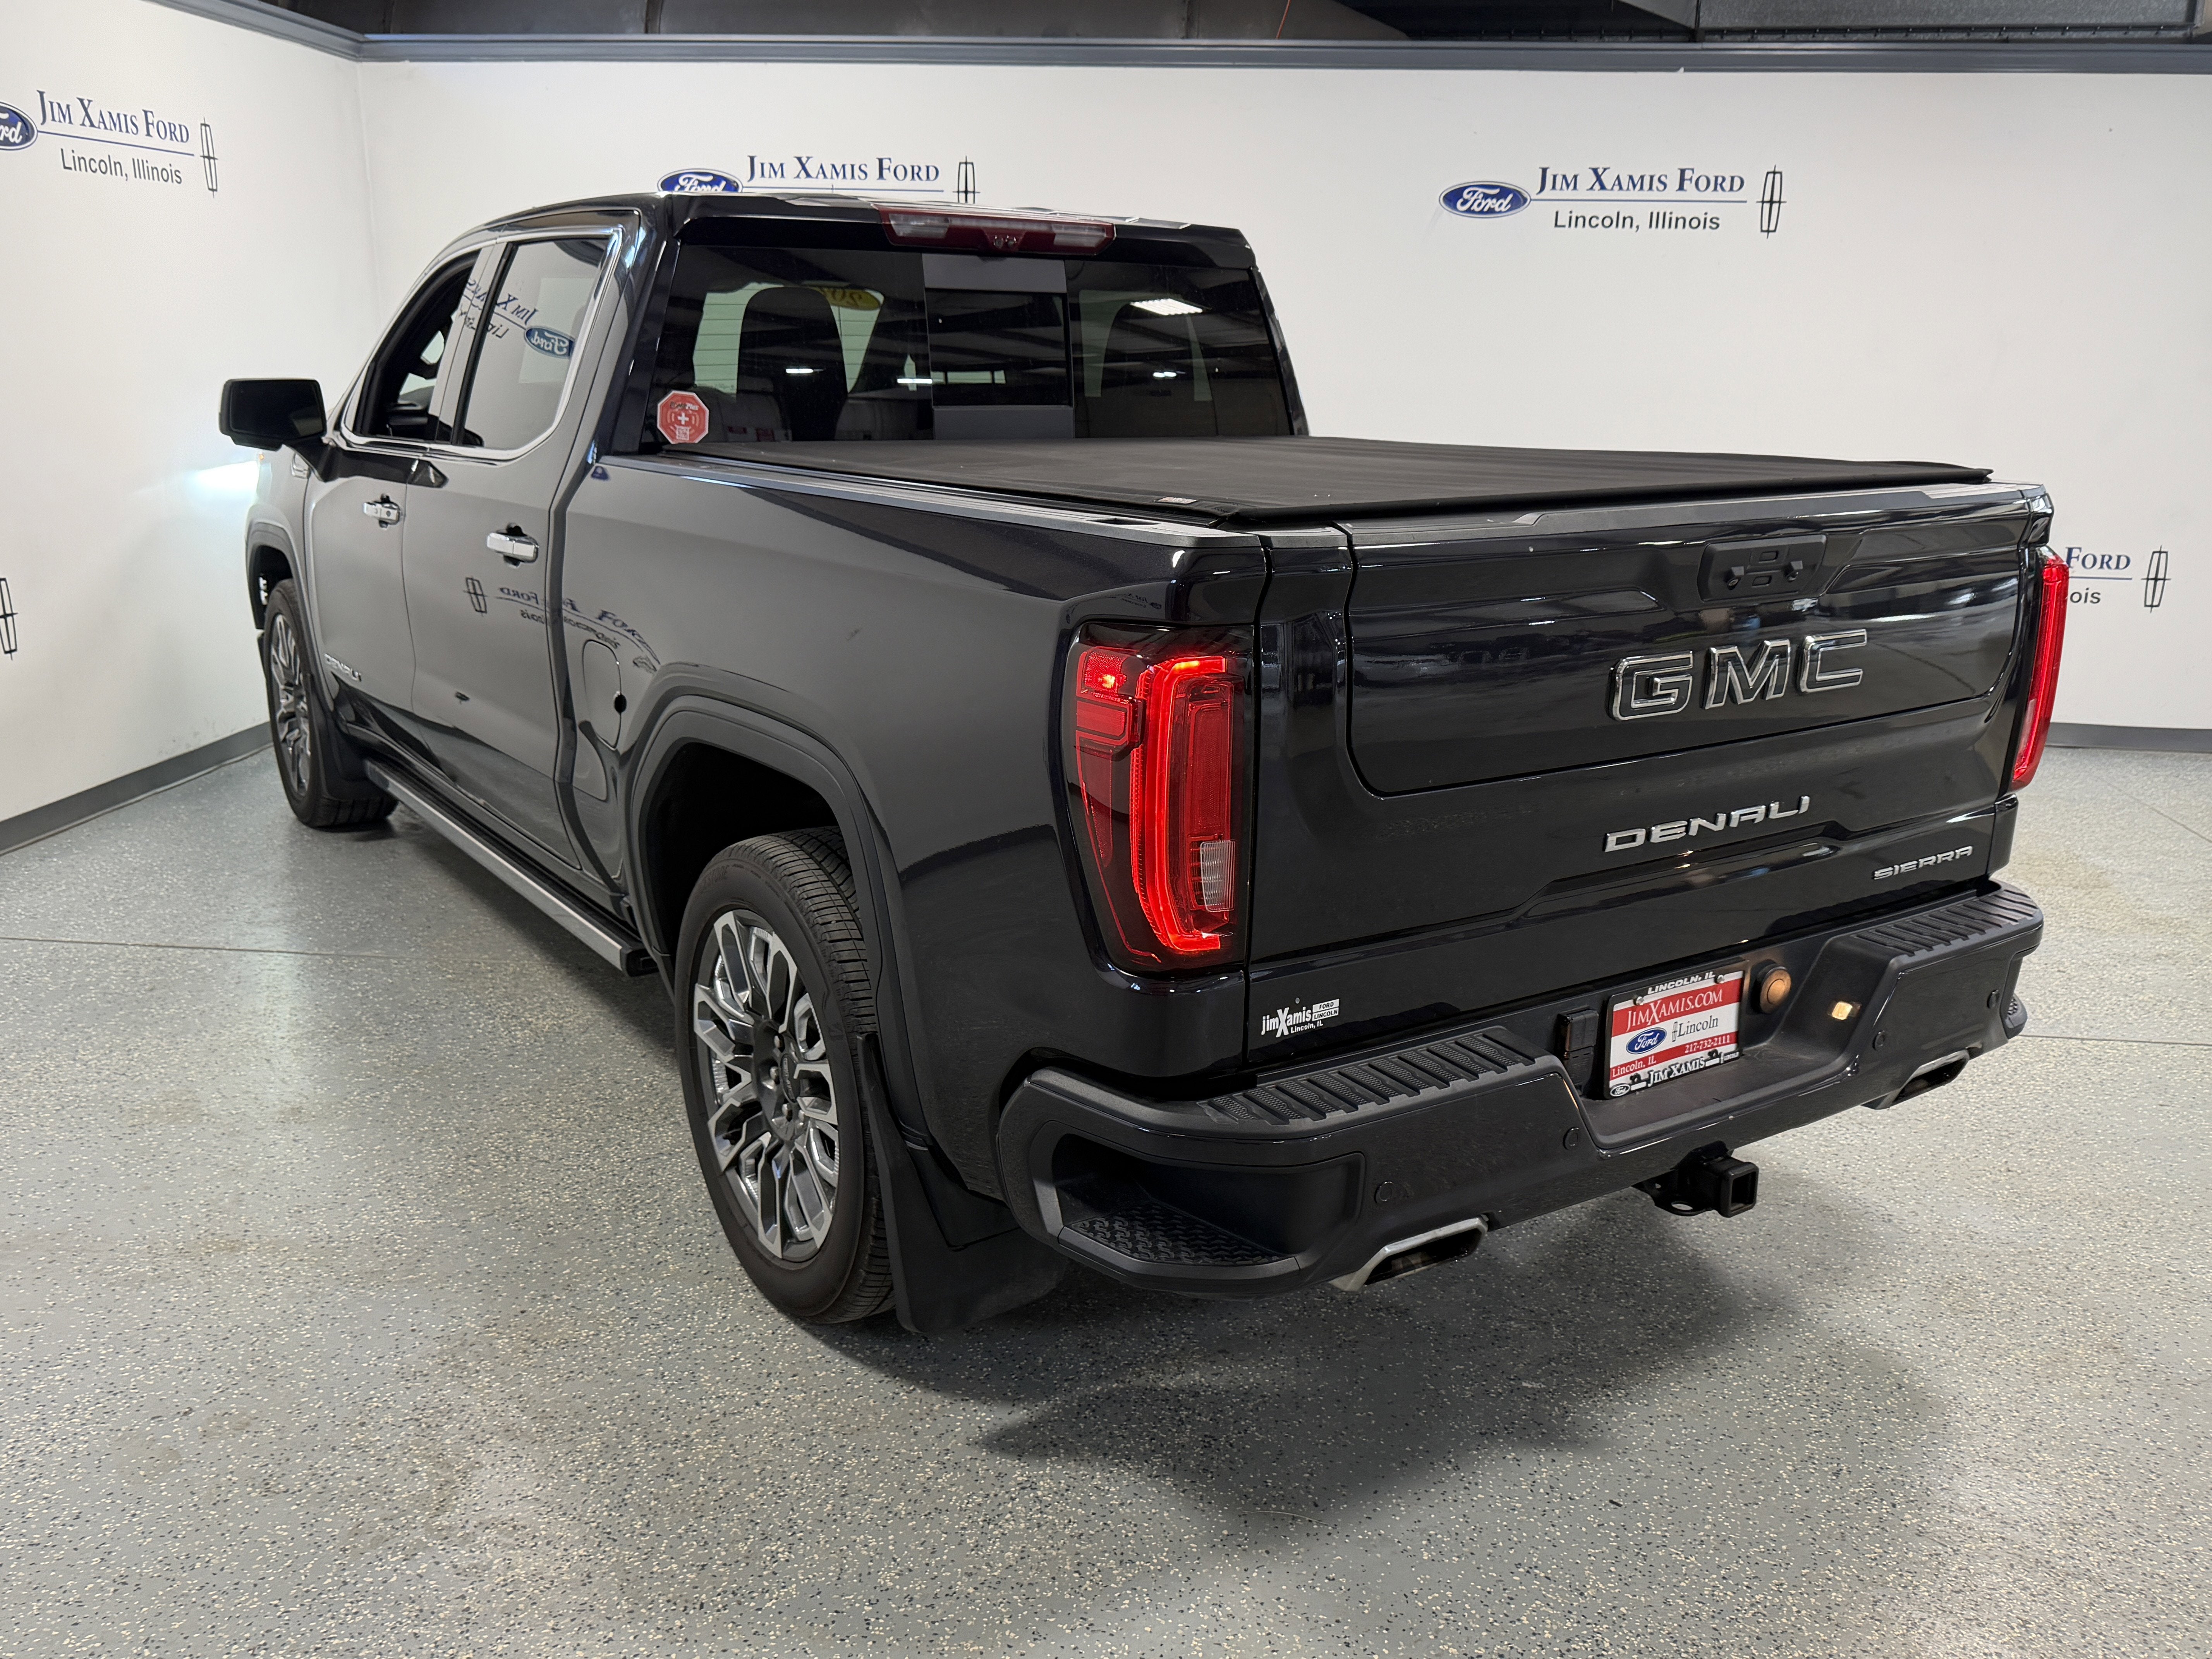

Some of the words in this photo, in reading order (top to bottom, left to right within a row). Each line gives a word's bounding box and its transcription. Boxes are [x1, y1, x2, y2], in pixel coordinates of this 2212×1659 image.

[36, 89, 74, 125] JIM
[76, 97, 139, 136] XAMIS
[141, 108, 189, 143] FORD
[60, 148, 128, 181] Lincoln,
[132, 158, 182, 184] Illinois
[747, 156, 785, 183] JIM
[793, 156, 868, 180] XAMIS
[876, 157, 939, 182] FORD
[1536, 167, 1579, 194] JIM
[1586, 167, 1668, 192] XAMIS
[1676, 167, 1745, 192] FORD
[1456, 187, 1511, 214] Ford
[1554, 210, 1640, 232] Lincoln,
[1648, 211, 1721, 230] Illinois
[2064, 546, 2131, 570] FORD
[1605, 629, 1868, 721] GMC
[1604, 795, 1810, 852] DENALI
[1873, 845, 1973, 880] SIERRA
[1647, 975, 1702, 994] LINCOLN,
[1704, 971, 1716, 980] IL
[1314, 1009, 1338, 1020] LINCOLN
[1319, 1001, 1334, 1010] FORD
[1290, 1022, 1315, 1034] Lincoln,
[1677, 1015, 1719, 1038] Lincoln
[1635, 1032, 1659, 1051] Ford
[1685, 1035, 1730, 1053] 217-732-2111
[1648, 1055, 1657, 1065] IL
[1648, 1068, 1669, 1087] JIM
[1669, 1058, 1706, 1076] XAMIS
